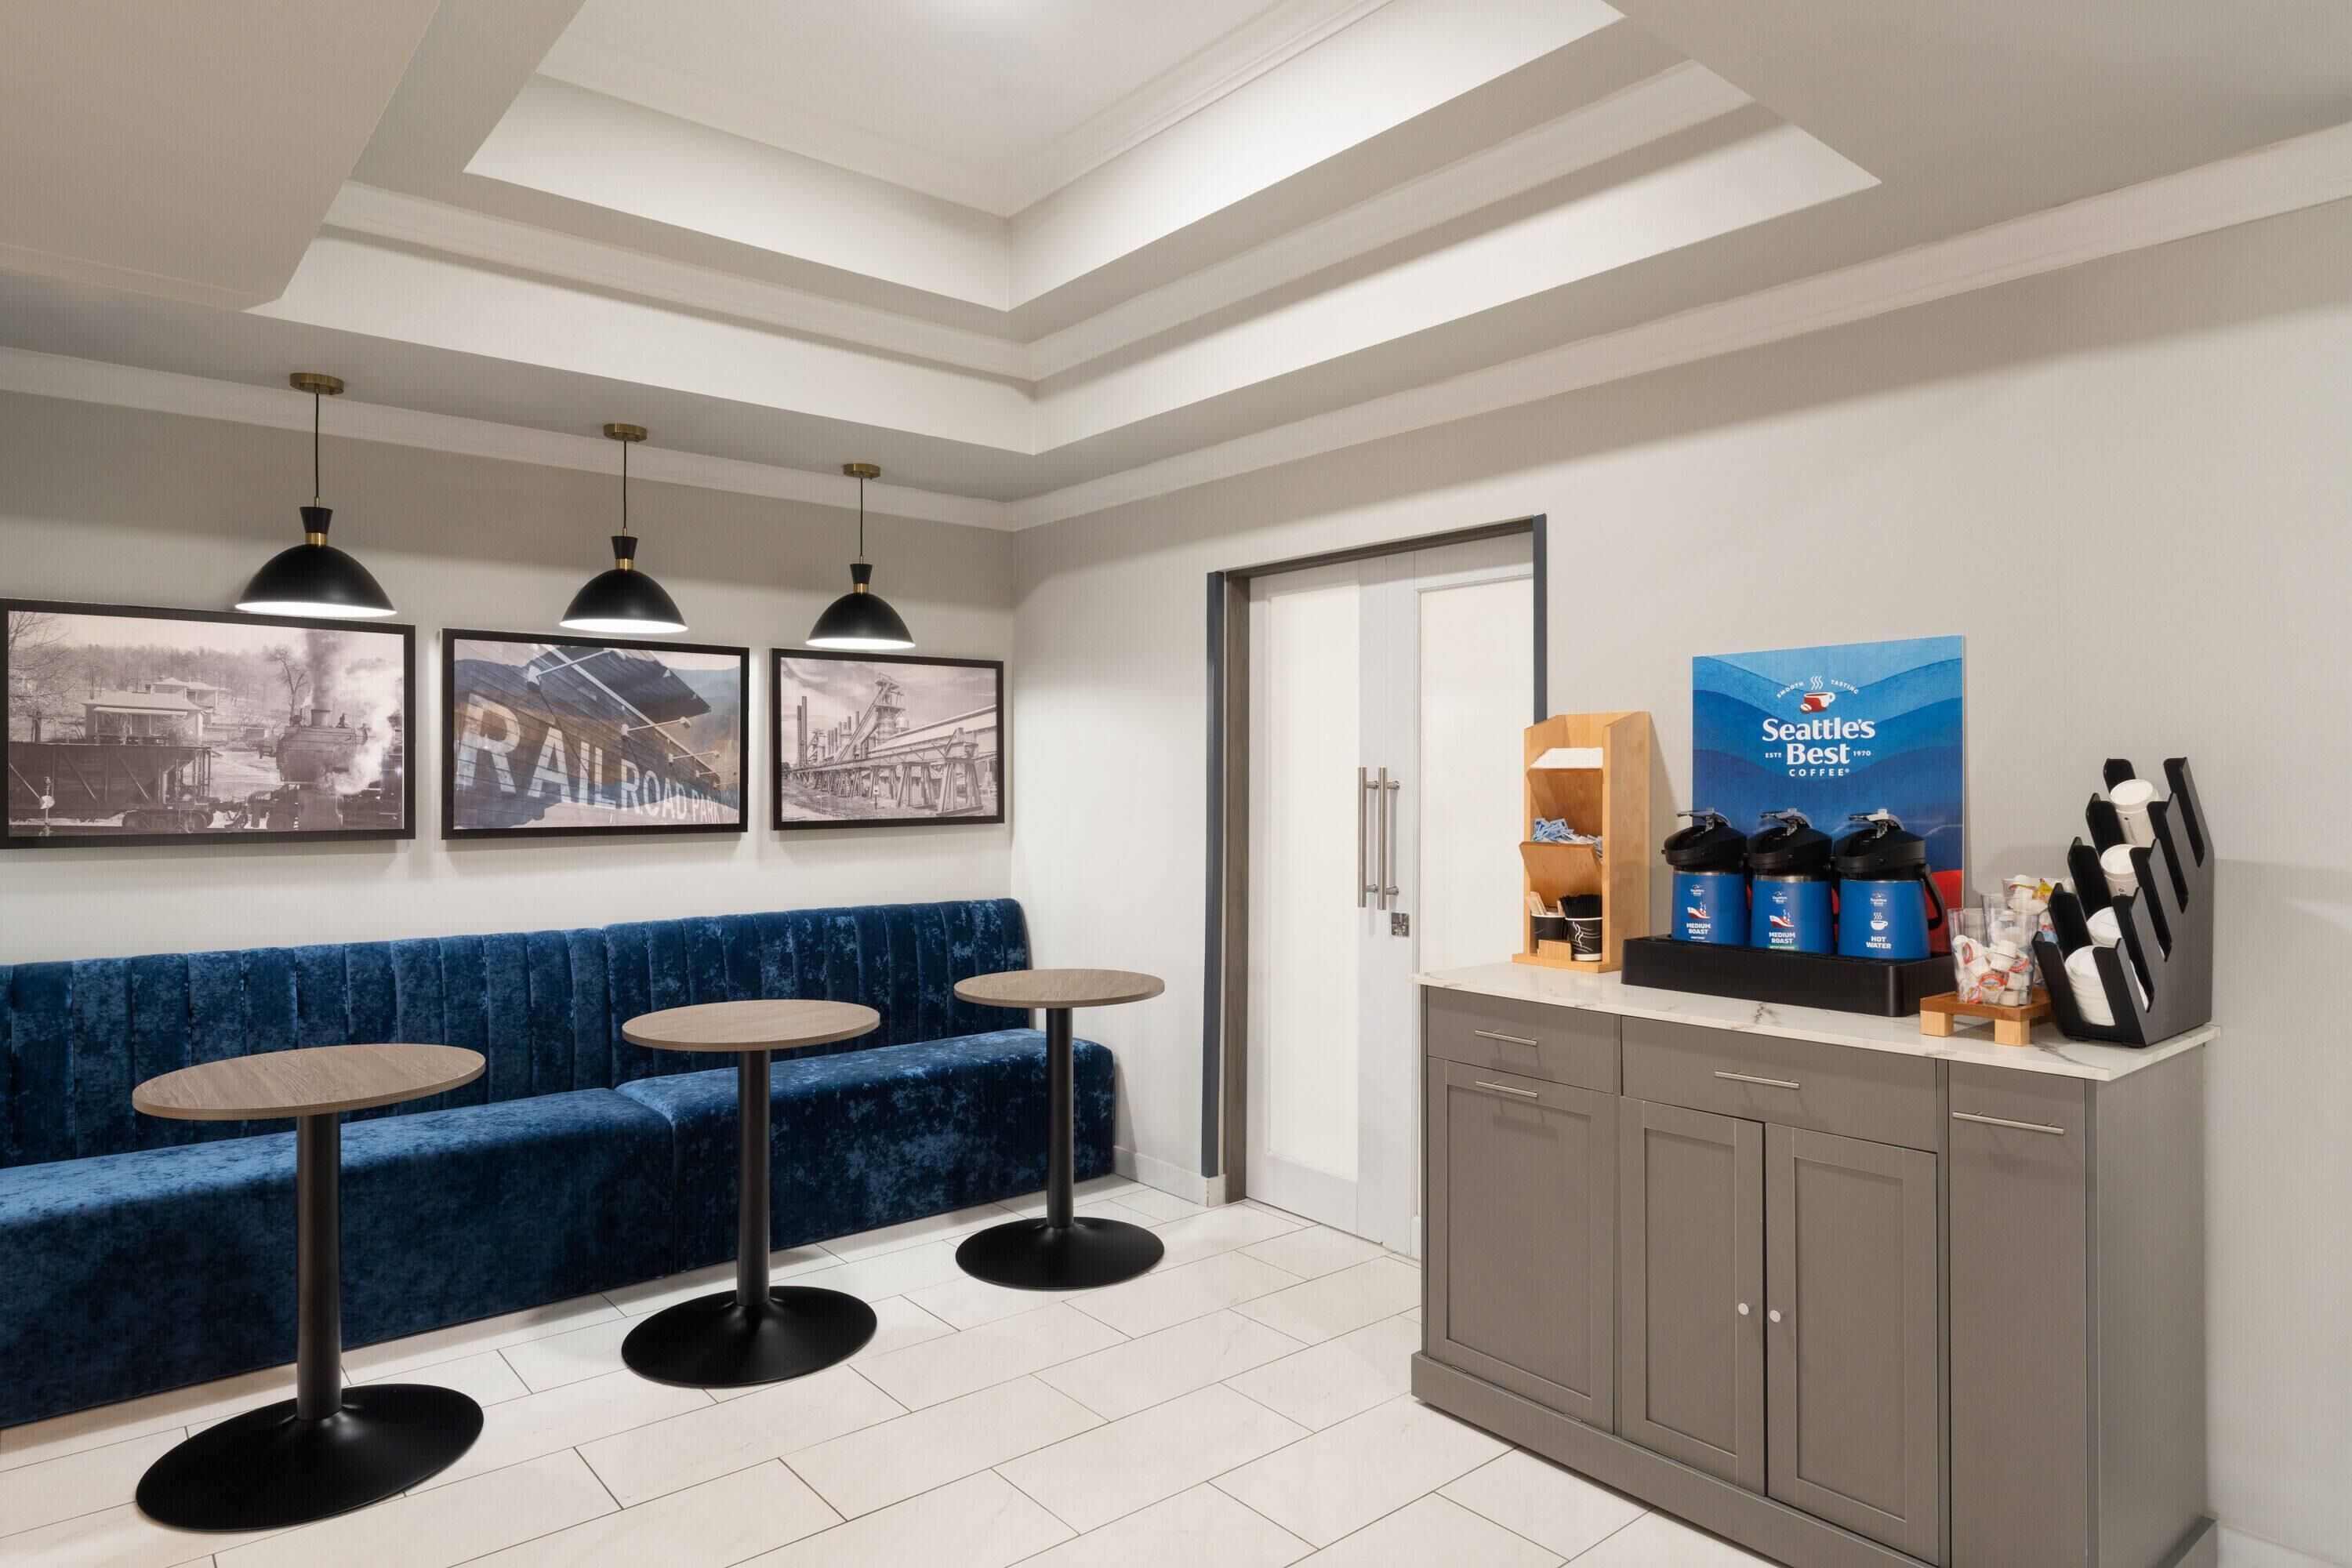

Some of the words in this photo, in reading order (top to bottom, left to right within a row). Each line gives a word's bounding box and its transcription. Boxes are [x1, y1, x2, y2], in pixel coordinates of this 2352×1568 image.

[1777, 681, 1804, 699] SMOOTH
[1831, 680, 1859, 695] TASTING
[1762, 717, 1876, 742] Seattle's
[1786, 743, 1850, 765] Best
[691, 789, 720, 824] PARK
